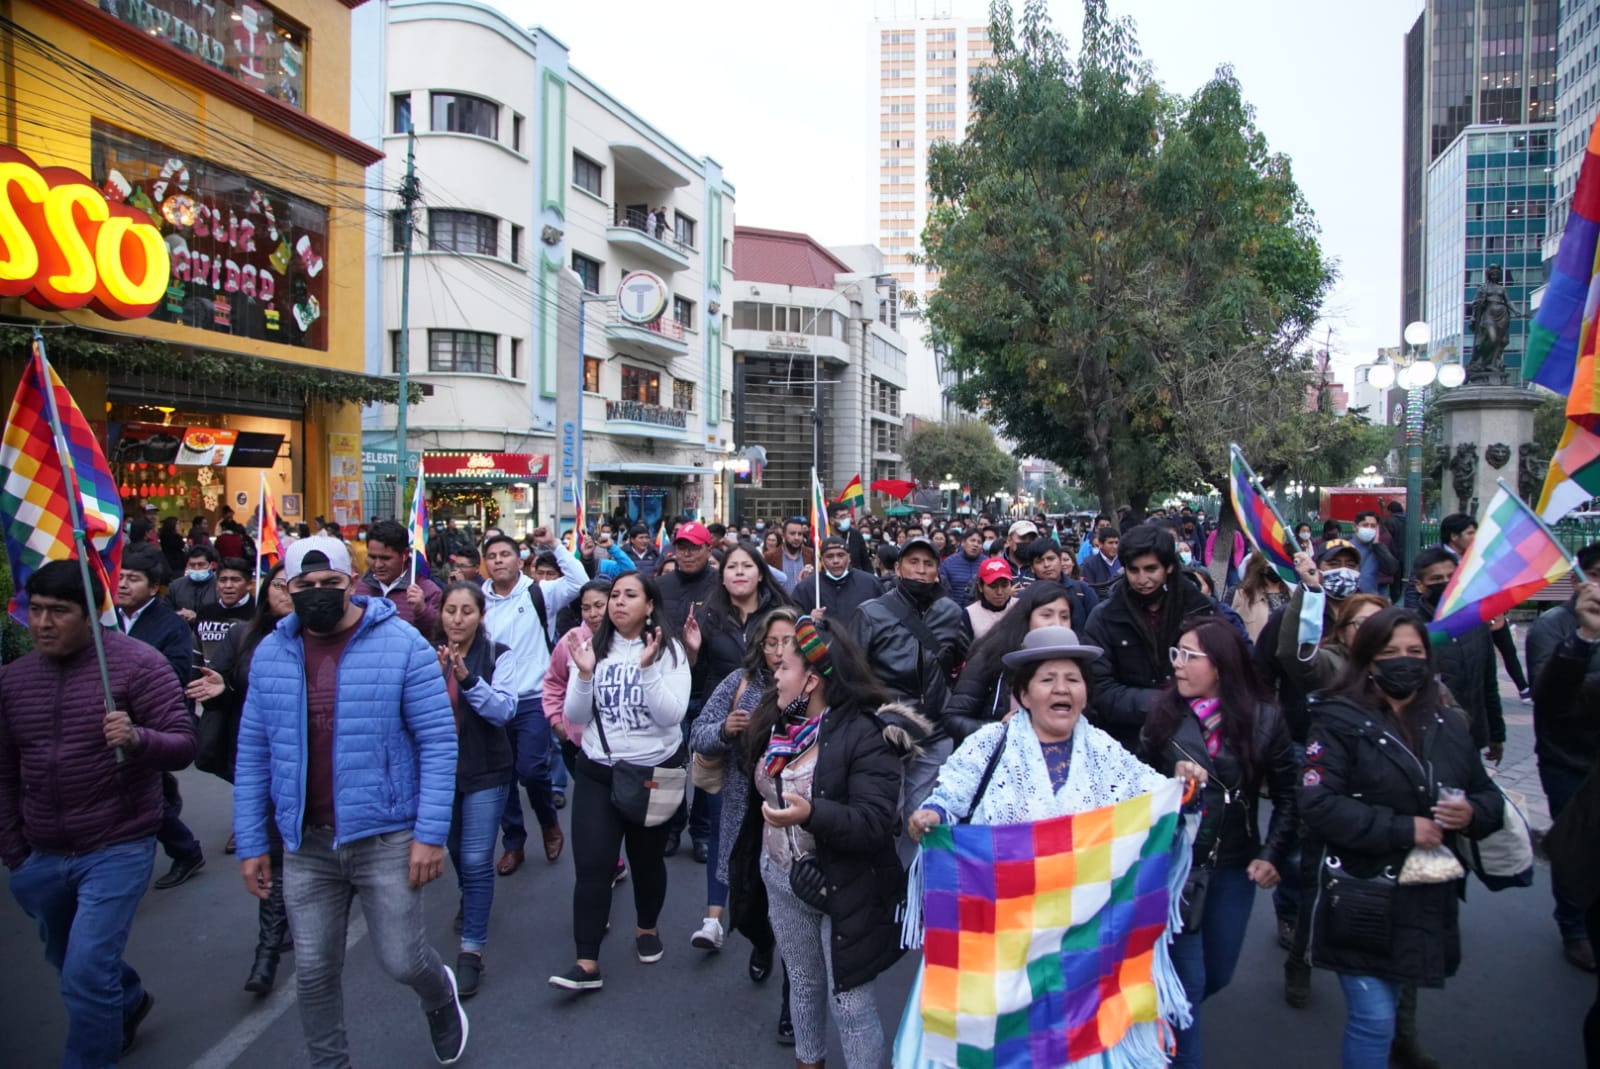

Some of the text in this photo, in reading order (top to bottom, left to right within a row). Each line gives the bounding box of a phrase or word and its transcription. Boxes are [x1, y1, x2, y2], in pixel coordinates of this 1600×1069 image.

[128, 0, 225, 66] NAVIDAD
[165, 241, 275, 301] AVIDAD
[563, 421, 575, 477] PRADO
[597, 685, 646, 706] NYLO
[600, 664, 642, 684] LOV
